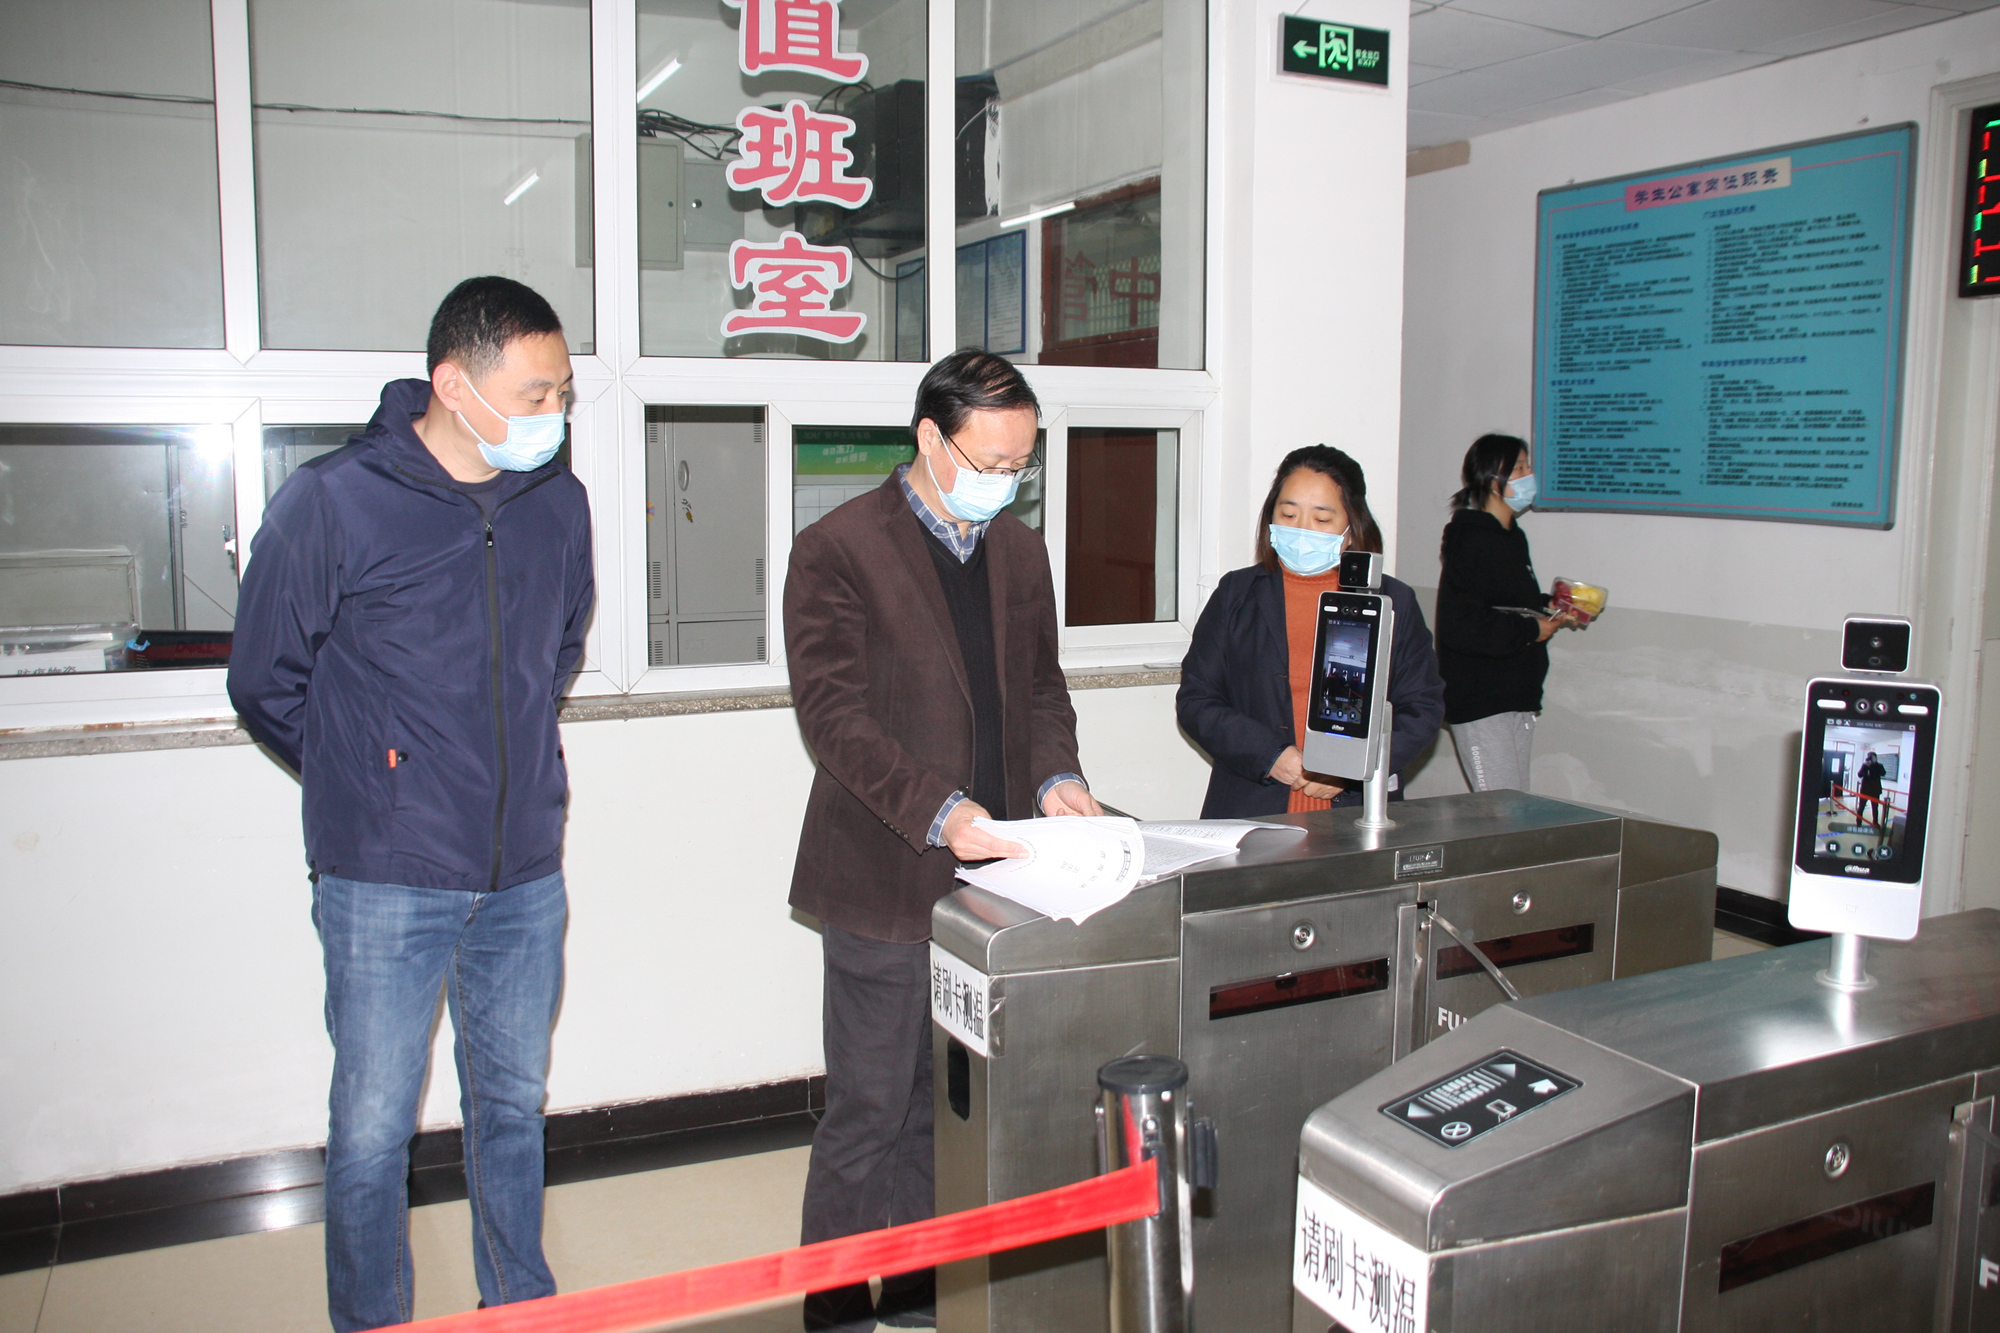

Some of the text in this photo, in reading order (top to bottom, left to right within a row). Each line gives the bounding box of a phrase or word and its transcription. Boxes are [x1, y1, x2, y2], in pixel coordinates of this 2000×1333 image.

[1357, 58, 1376, 68] EXIT
[722, 0, 871, 341] 值班室
[933, 960, 985, 1041] 请刷卡测温
[1438, 1006, 1468, 1032] FU
[1302, 1205, 1416, 1333] 请刷卡测温
